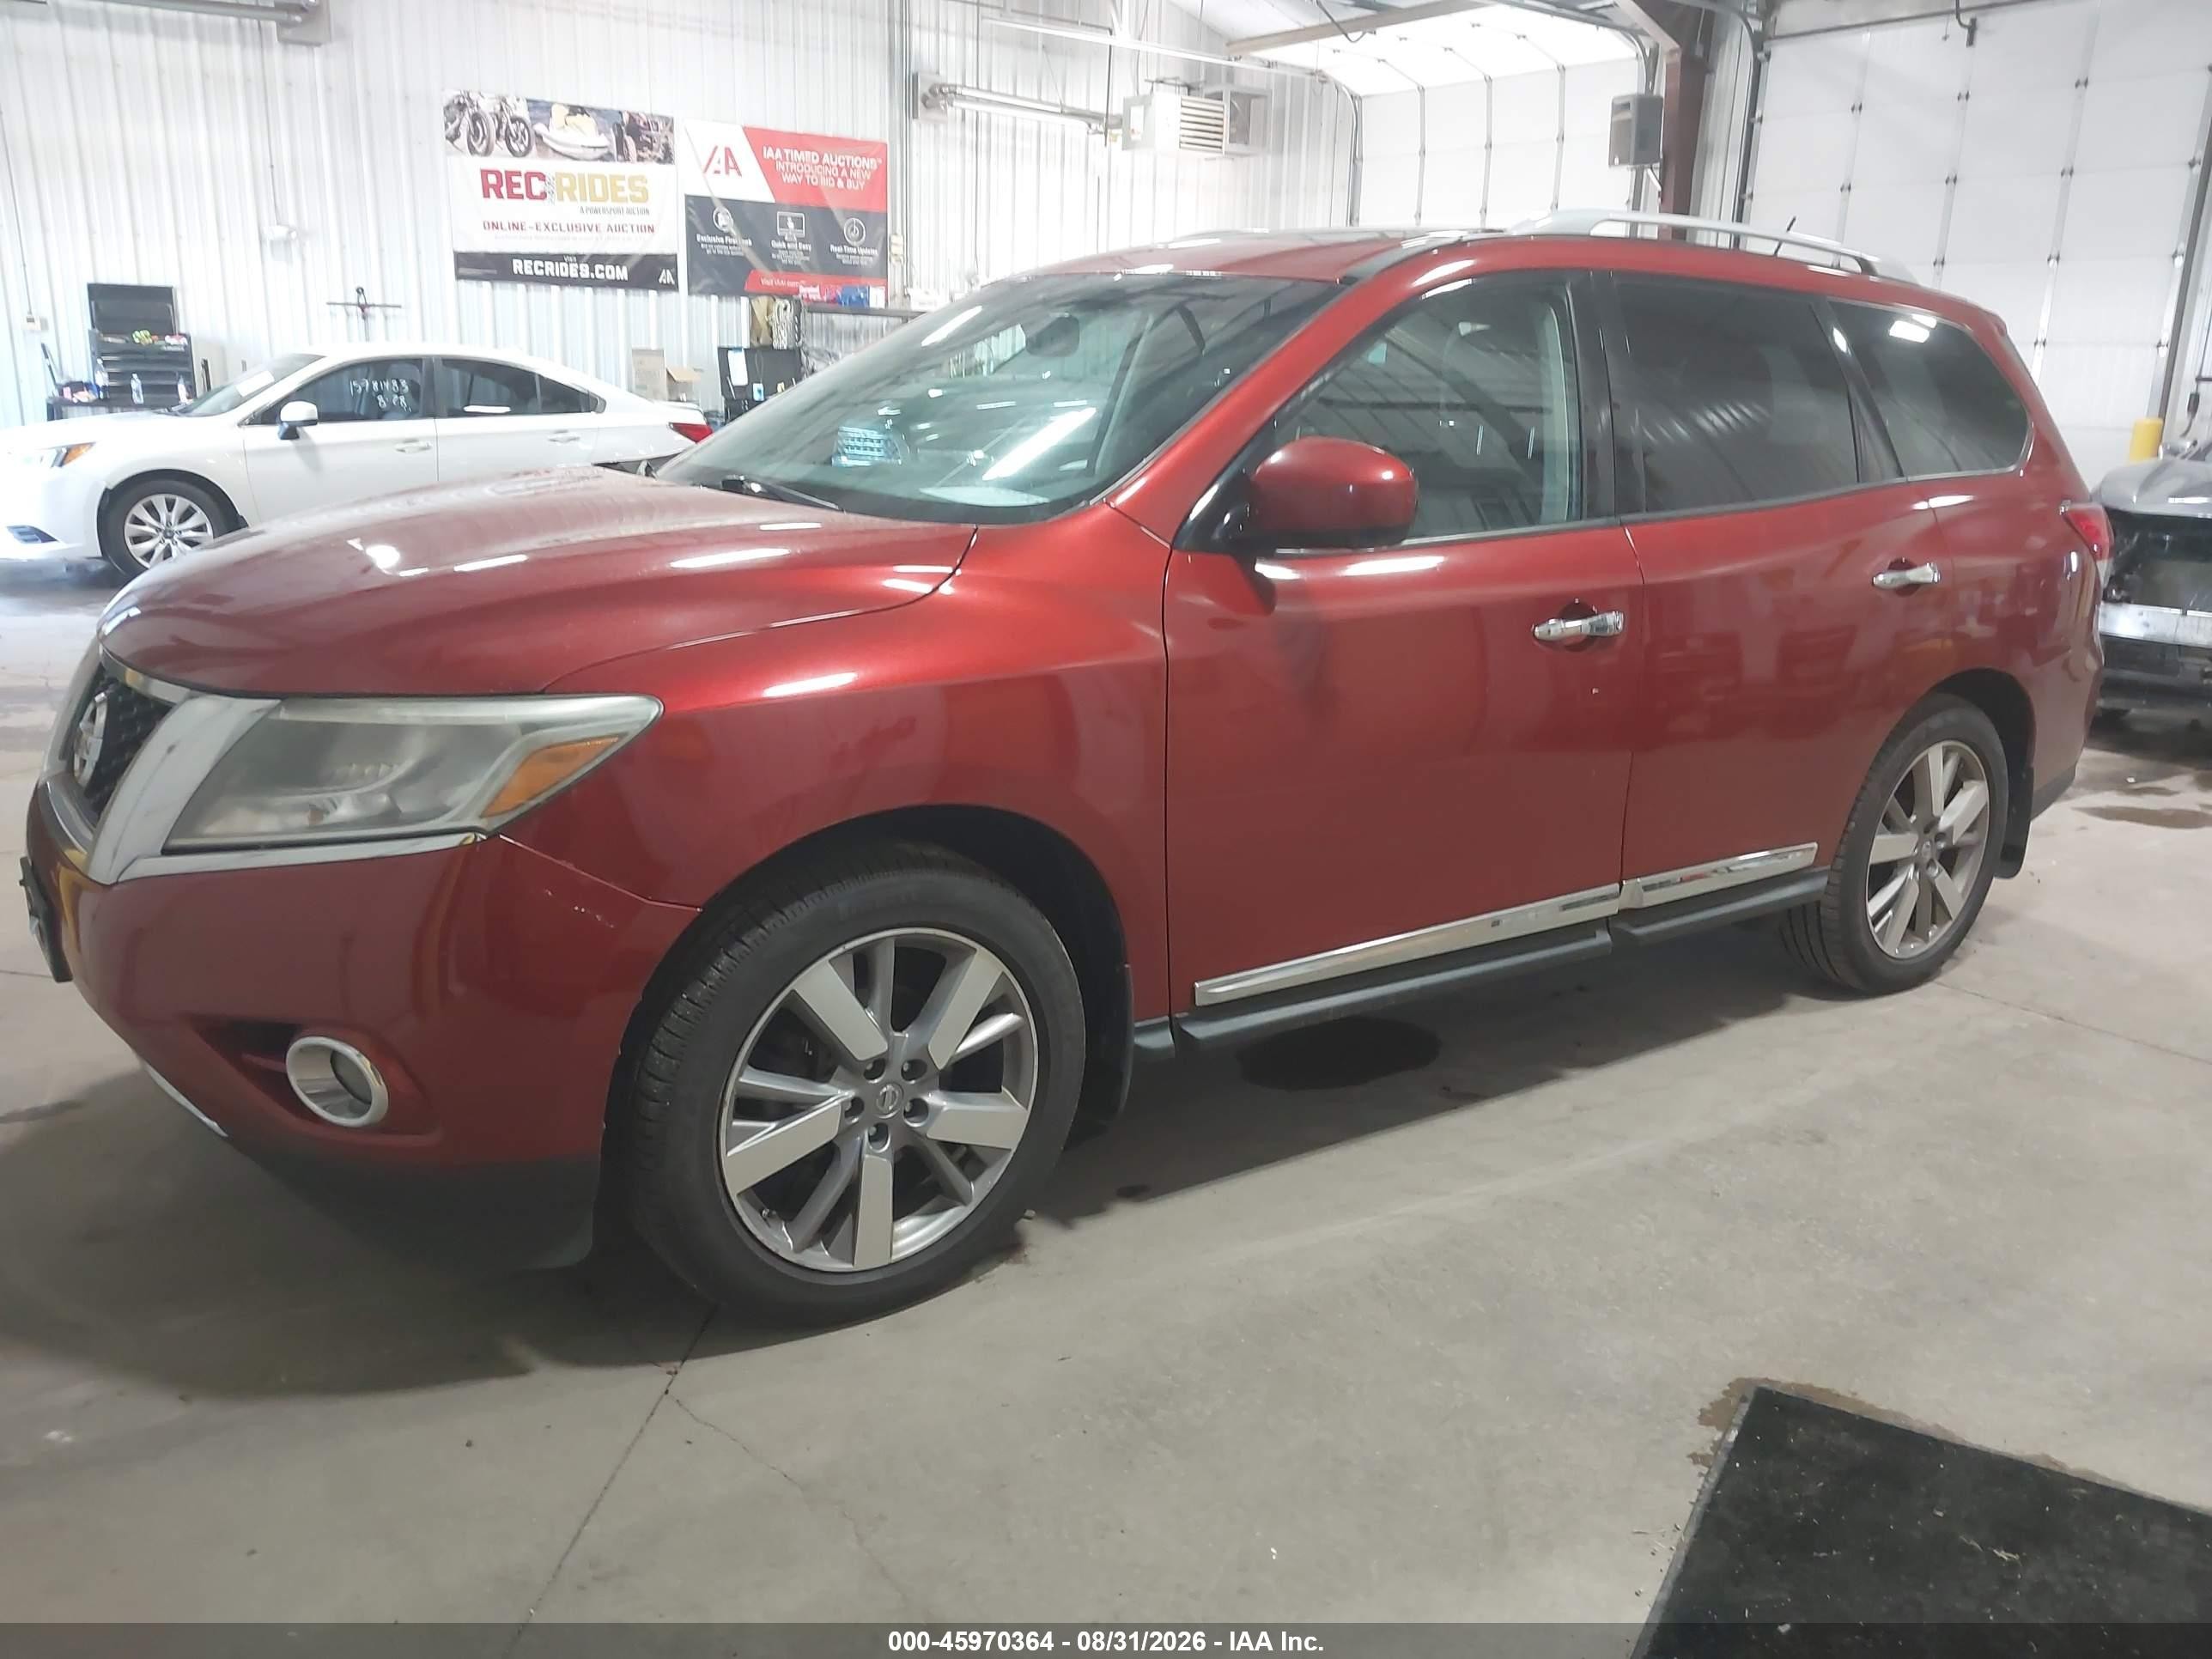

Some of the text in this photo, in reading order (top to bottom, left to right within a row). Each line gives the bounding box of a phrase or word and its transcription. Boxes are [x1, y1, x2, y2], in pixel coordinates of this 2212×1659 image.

[763, 145, 782, 161] IAA
[782, 148, 820, 164] TIMED
[775, 161, 872, 179] INTRODUCING A NEW
[479, 167, 650, 204] REC RIDES
[781, 172, 803, 184] WAY
[805, 174, 818, 185] TO
[846, 179, 866, 191] BUY
[482, 220, 656, 234] ONLINE-EXCLUSIVE AUCTION
[512, 258, 629, 282] RECRIDES.COM
